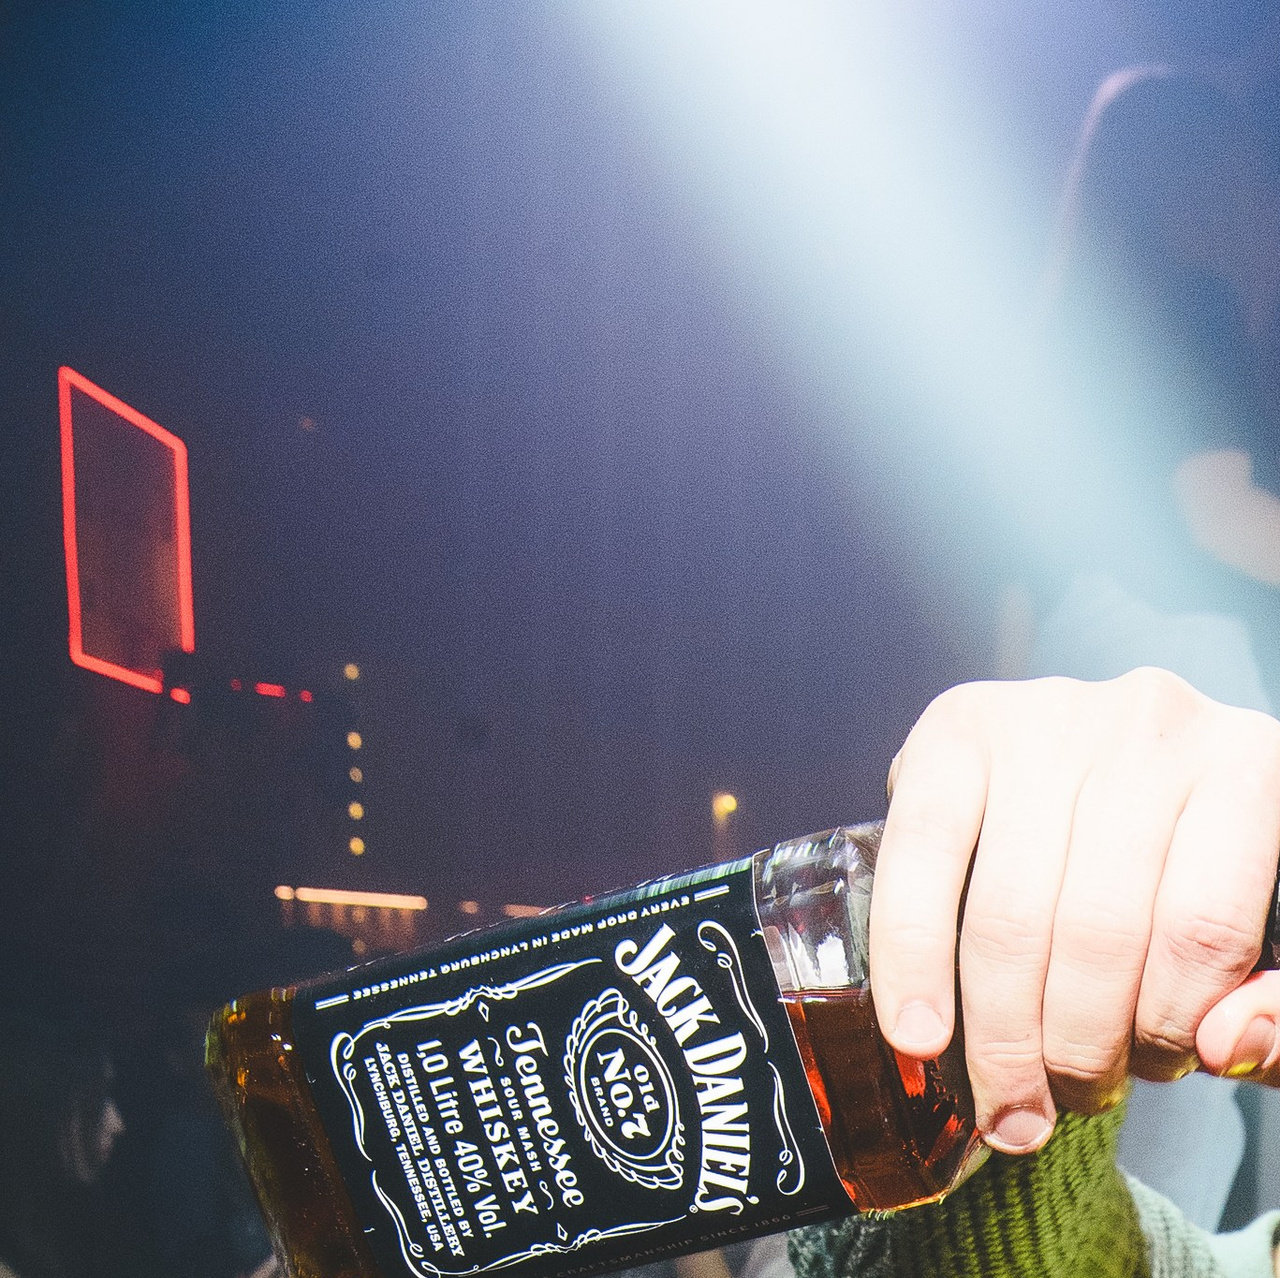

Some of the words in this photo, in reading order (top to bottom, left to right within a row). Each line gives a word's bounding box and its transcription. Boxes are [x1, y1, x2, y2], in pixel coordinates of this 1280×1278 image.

[551, 922, 594, 943] MADE
[597, 910, 639, 930] DROP
[641, 895, 690, 919] EVERY
[440, 940, 530, 975] LYNCHBURG
[532, 935, 548, 948] IN
[352, 967, 438, 1001] TENNESSEE
[614, 922, 721, 1048] JACK
[682, 1030, 761, 1217] DANIEL'S
[633, 1063, 661, 1113] Old
[458, 1038, 540, 1215] WHISKEY
[500, 1076, 523, 1121] SOUR
[516, 1125, 542, 1172] MASH
[506, 1021, 585, 1208] Tennessee
[590, 1075, 615, 1128] BRAND
[363, 1056, 401, 1143] LYNCHBURG,
[395, 1143, 428, 1223] TENNESSEE,
[426, 1224, 444, 1252] USA
[375, 1041, 399, 1090] JACK
[390, 1087, 424, 1157] DANIEL
[416, 1157, 465, 1257] DISTILLERY
[396, 1052, 430, 1123] DISTILLED
[422, 1126, 441, 1156] AND
[433, 1157, 465, 1218] BOTTLED
[457, 1219, 475, 1238] BY
[429, 1076, 464, 1134] Litre
[453, 1140, 493, 1193] 40%
[473, 1193, 508, 1239] Vol.
[700, 1224, 750, 1243] SINCE
